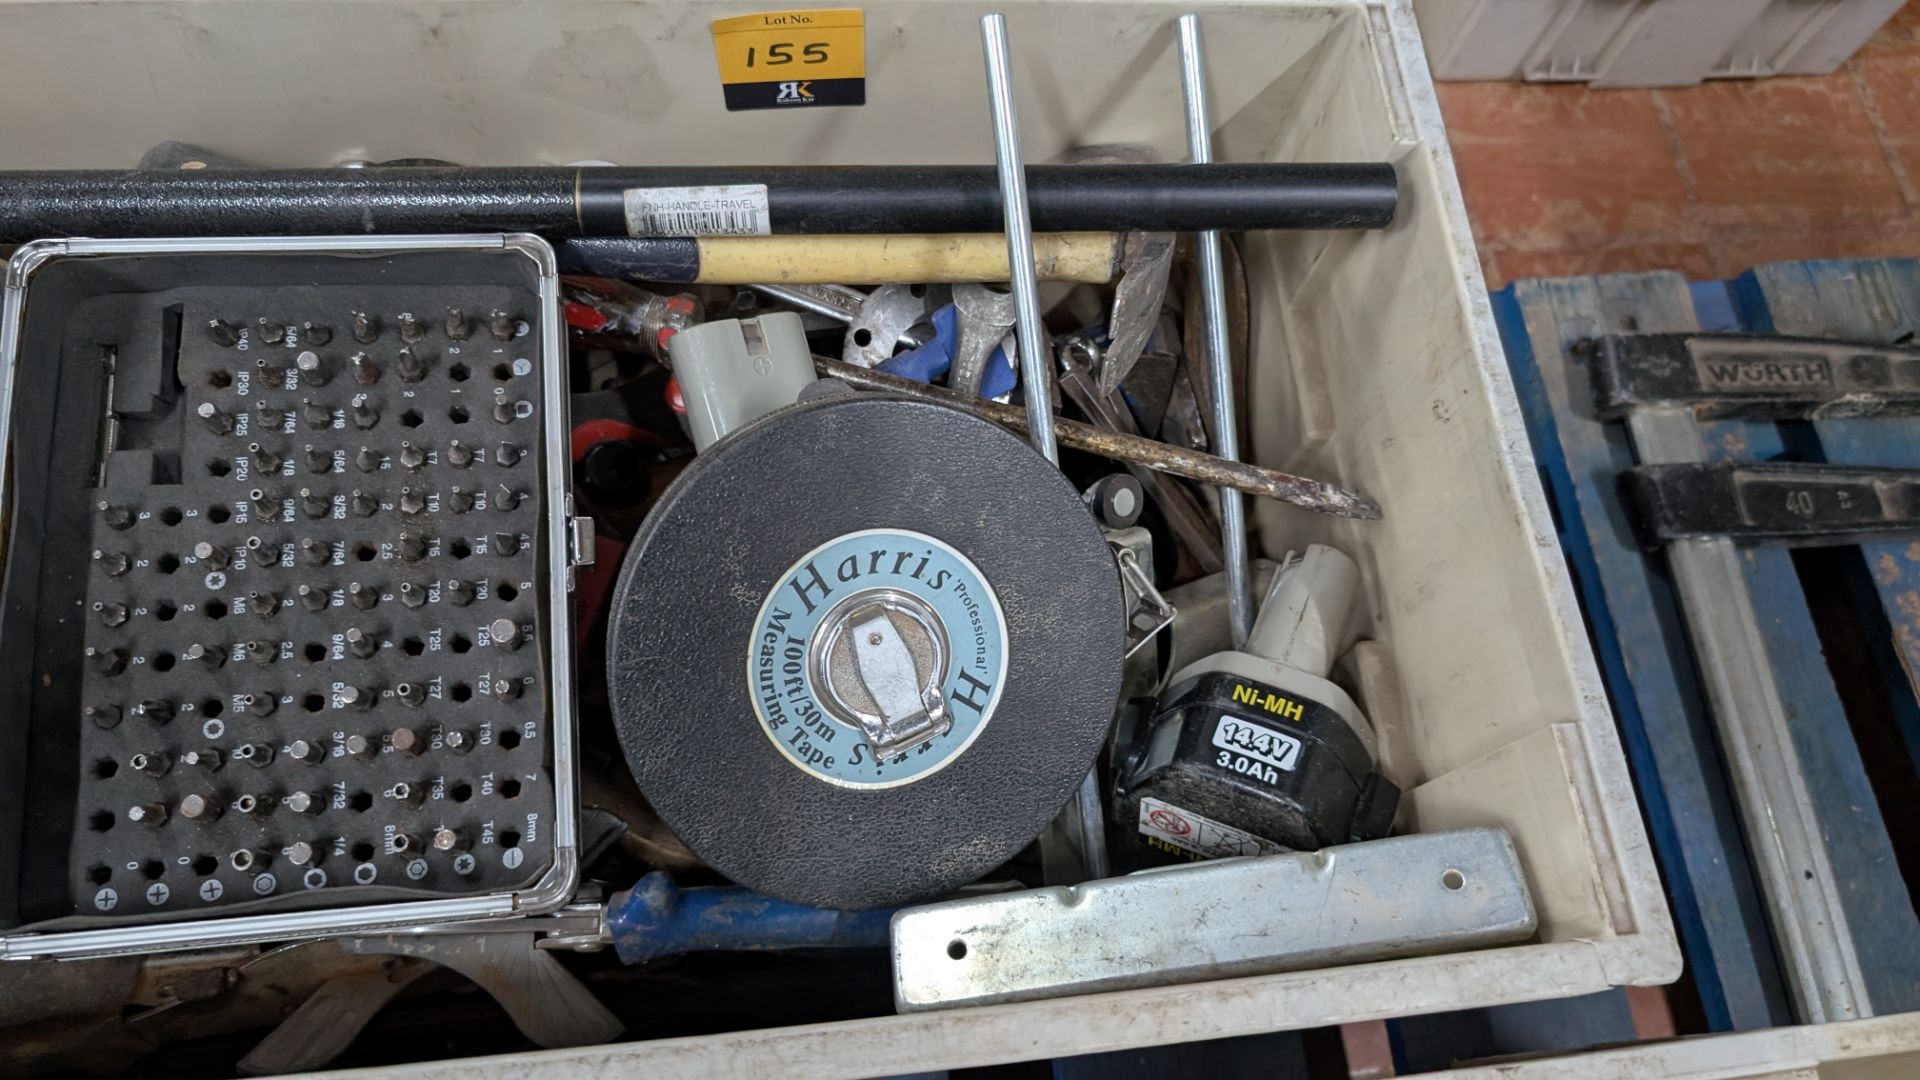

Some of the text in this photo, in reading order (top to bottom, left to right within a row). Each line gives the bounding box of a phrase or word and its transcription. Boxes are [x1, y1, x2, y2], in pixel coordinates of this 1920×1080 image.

[765, 14, 813, 26] Lot No.
[746, 42, 830, 68] 155
[285, 326, 297, 349] 5/64
[237, 371, 250, 396] IP30
[285, 368, 298, 391] 3/32
[404, 390, 415, 398] 2
[236, 413, 248, 437] IP25
[284, 411, 296, 434] 7/64
[333, 408, 346, 429] 1/16
[334, 450, 346, 474] 5/64
[428, 451, 438, 466] T7
[474, 448, 486, 462] T7
[236, 456, 248, 482] IP20
[283, 458, 296, 477] 1/8
[334, 494, 346, 520] 3/32
[382, 503, 394, 512] 2
[427, 492, 440, 513] T10
[474, 490, 487, 510] T10
[1786, 489, 1815, 516] 40
[138, 512, 151, 520] 3
[186, 510, 198, 518] 3
[235, 501, 248, 524] IP15
[282, 543, 295, 568] 5/32
[332, 540, 345, 566] 7/64
[428, 537, 441, 557] T15
[476, 534, 488, 554] T15
[136, 560, 150, 568] 2
[185, 556, 198, 564] 2
[235, 546, 248, 570] IP10
[428, 580, 441, 603] T20
[476, 578, 488, 600] T20
[520, 582, 532, 590] 5
[789, 549, 952, 616] Harris
[184, 604, 196, 612] 2
[233, 597, 246, 615] M8
[282, 600, 295, 608] 2
[332, 588, 345, 607] 1/8
[381, 593, 394, 602] 3
[135, 608, 148, 616] 2
[332, 634, 345, 660] 9/64
[381, 640, 394, 649] 4
[429, 628, 442, 651] T25
[478, 624, 490, 647] T25
[132, 656, 146, 665] 2
[232, 643, 246, 662] M6
[332, 682, 345, 709] 5/32
[382, 690, 394, 698] 5
[428, 676, 442, 700] T27
[478, 672, 491, 696] T27
[760, 606, 836, 770] Measuring Tape
[783, 637, 838, 743] 100ft/30m
[282, 694, 294, 704] 3
[1232, 684, 1304, 722] Ni-MH
[431, 724, 444, 750] T30
[479, 721, 492, 745] T30
[524, 722, 536, 740] 6.5
[1223, 723, 1293, 761] 14.4V
[332, 731, 346, 757] 3/16
[524, 773, 537, 781] 7
[1216, 751, 1280, 786] 3.0Ah
[332, 781, 346, 810] 7/32
[432, 776, 444, 800] T35
[480, 772, 494, 796] T40
[481, 820, 494, 845] T45
[526, 812, 539, 843] 8mm
[333, 836, 346, 856] 1/4
